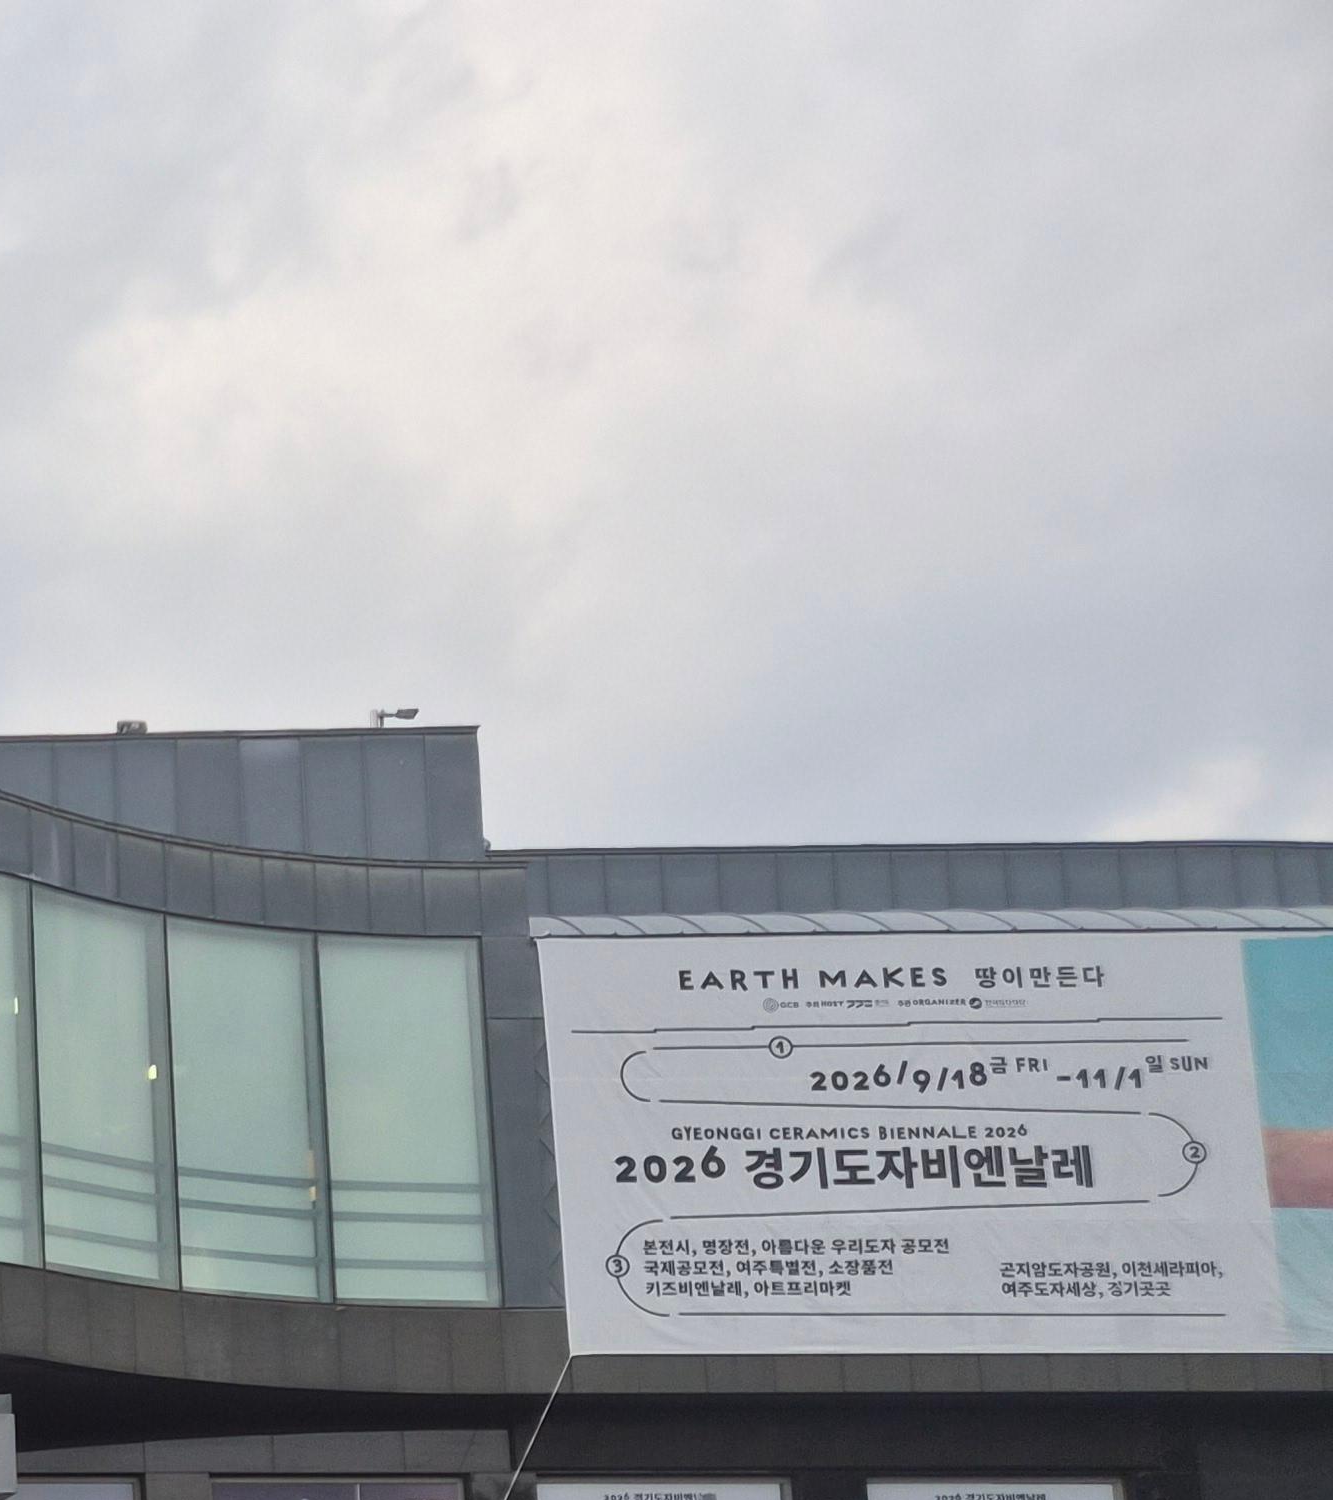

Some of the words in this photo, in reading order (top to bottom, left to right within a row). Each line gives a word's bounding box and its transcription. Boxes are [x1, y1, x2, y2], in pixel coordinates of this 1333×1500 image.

[679, 968, 799, 990] EARTH
[819, 967, 948, 989] MAKES
[1016, 1057, 1048, 1073] FRI
[1170, 1056, 1209, 1072] SUN
[671, 1127, 762, 1141] GYEONGGI
[769, 1127, 870, 1140] CERAMICS
[878, 1126, 977, 1140] BIENNALE
[984, 1124, 1028, 1139] 2026
[614, 1144, 727, 1184] 2026
[745, 1145, 1095, 1190] 경기도자비엔날레
[643, 1239, 697, 1257] 본전시,
[702, 1238, 757, 1256] 명장전,
[762, 1239, 826, 1255] 아름다운
[831, 1238, 896, 1255] 우리도자
[901, 1237, 950, 1254] 공모전
[644, 1260, 731, 1278] 국제공모전,
[736, 1260, 824, 1277] 여주특별전,
[829, 1259, 894, 1276] 소장품전
[1000, 1262, 1117, 1280] 곤지암도자공원,
[1122, 1261, 1224, 1279] 이천세라피아,
[646, 1281, 748, 1299] 키즈비엔날레,
[754, 1280, 851, 1297] 아트프리마켓
[1001, 1281, 1104, 1299] 여주도자세상,
